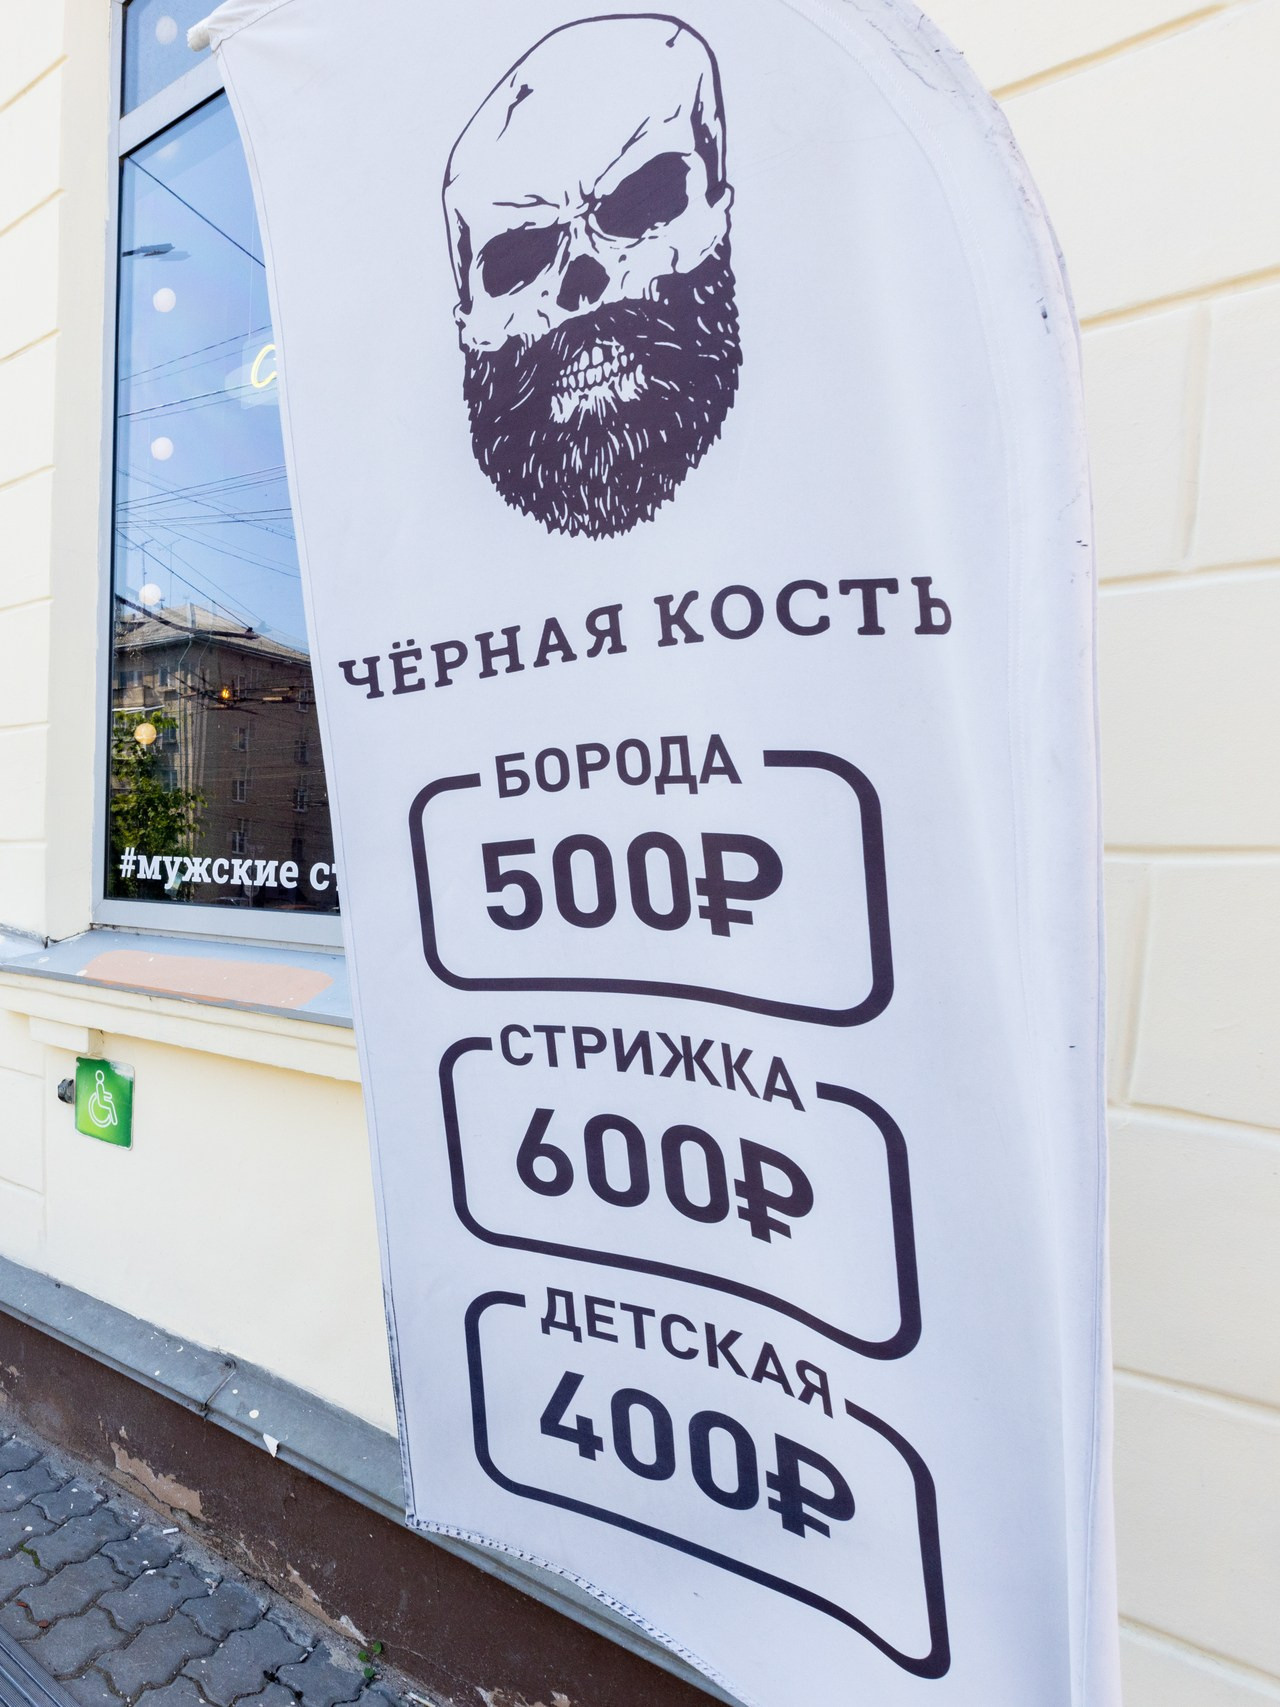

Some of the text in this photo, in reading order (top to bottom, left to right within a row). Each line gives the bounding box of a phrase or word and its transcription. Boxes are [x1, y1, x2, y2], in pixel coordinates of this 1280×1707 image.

[338, 576, 953, 700] ЧЁРНАЯ КОСТЬ
[495, 733, 743, 799] БОРОДА
[119, 846, 300, 891] #мужские
[481, 831, 784, 938] 500₽
[499, 1023, 807, 1113] СТРИЖКА
[516, 1107, 814, 1244] 600₽
[540, 1286, 835, 1419] ДЕТСКАЯ
[539, 1370, 856, 1539] 400₽
